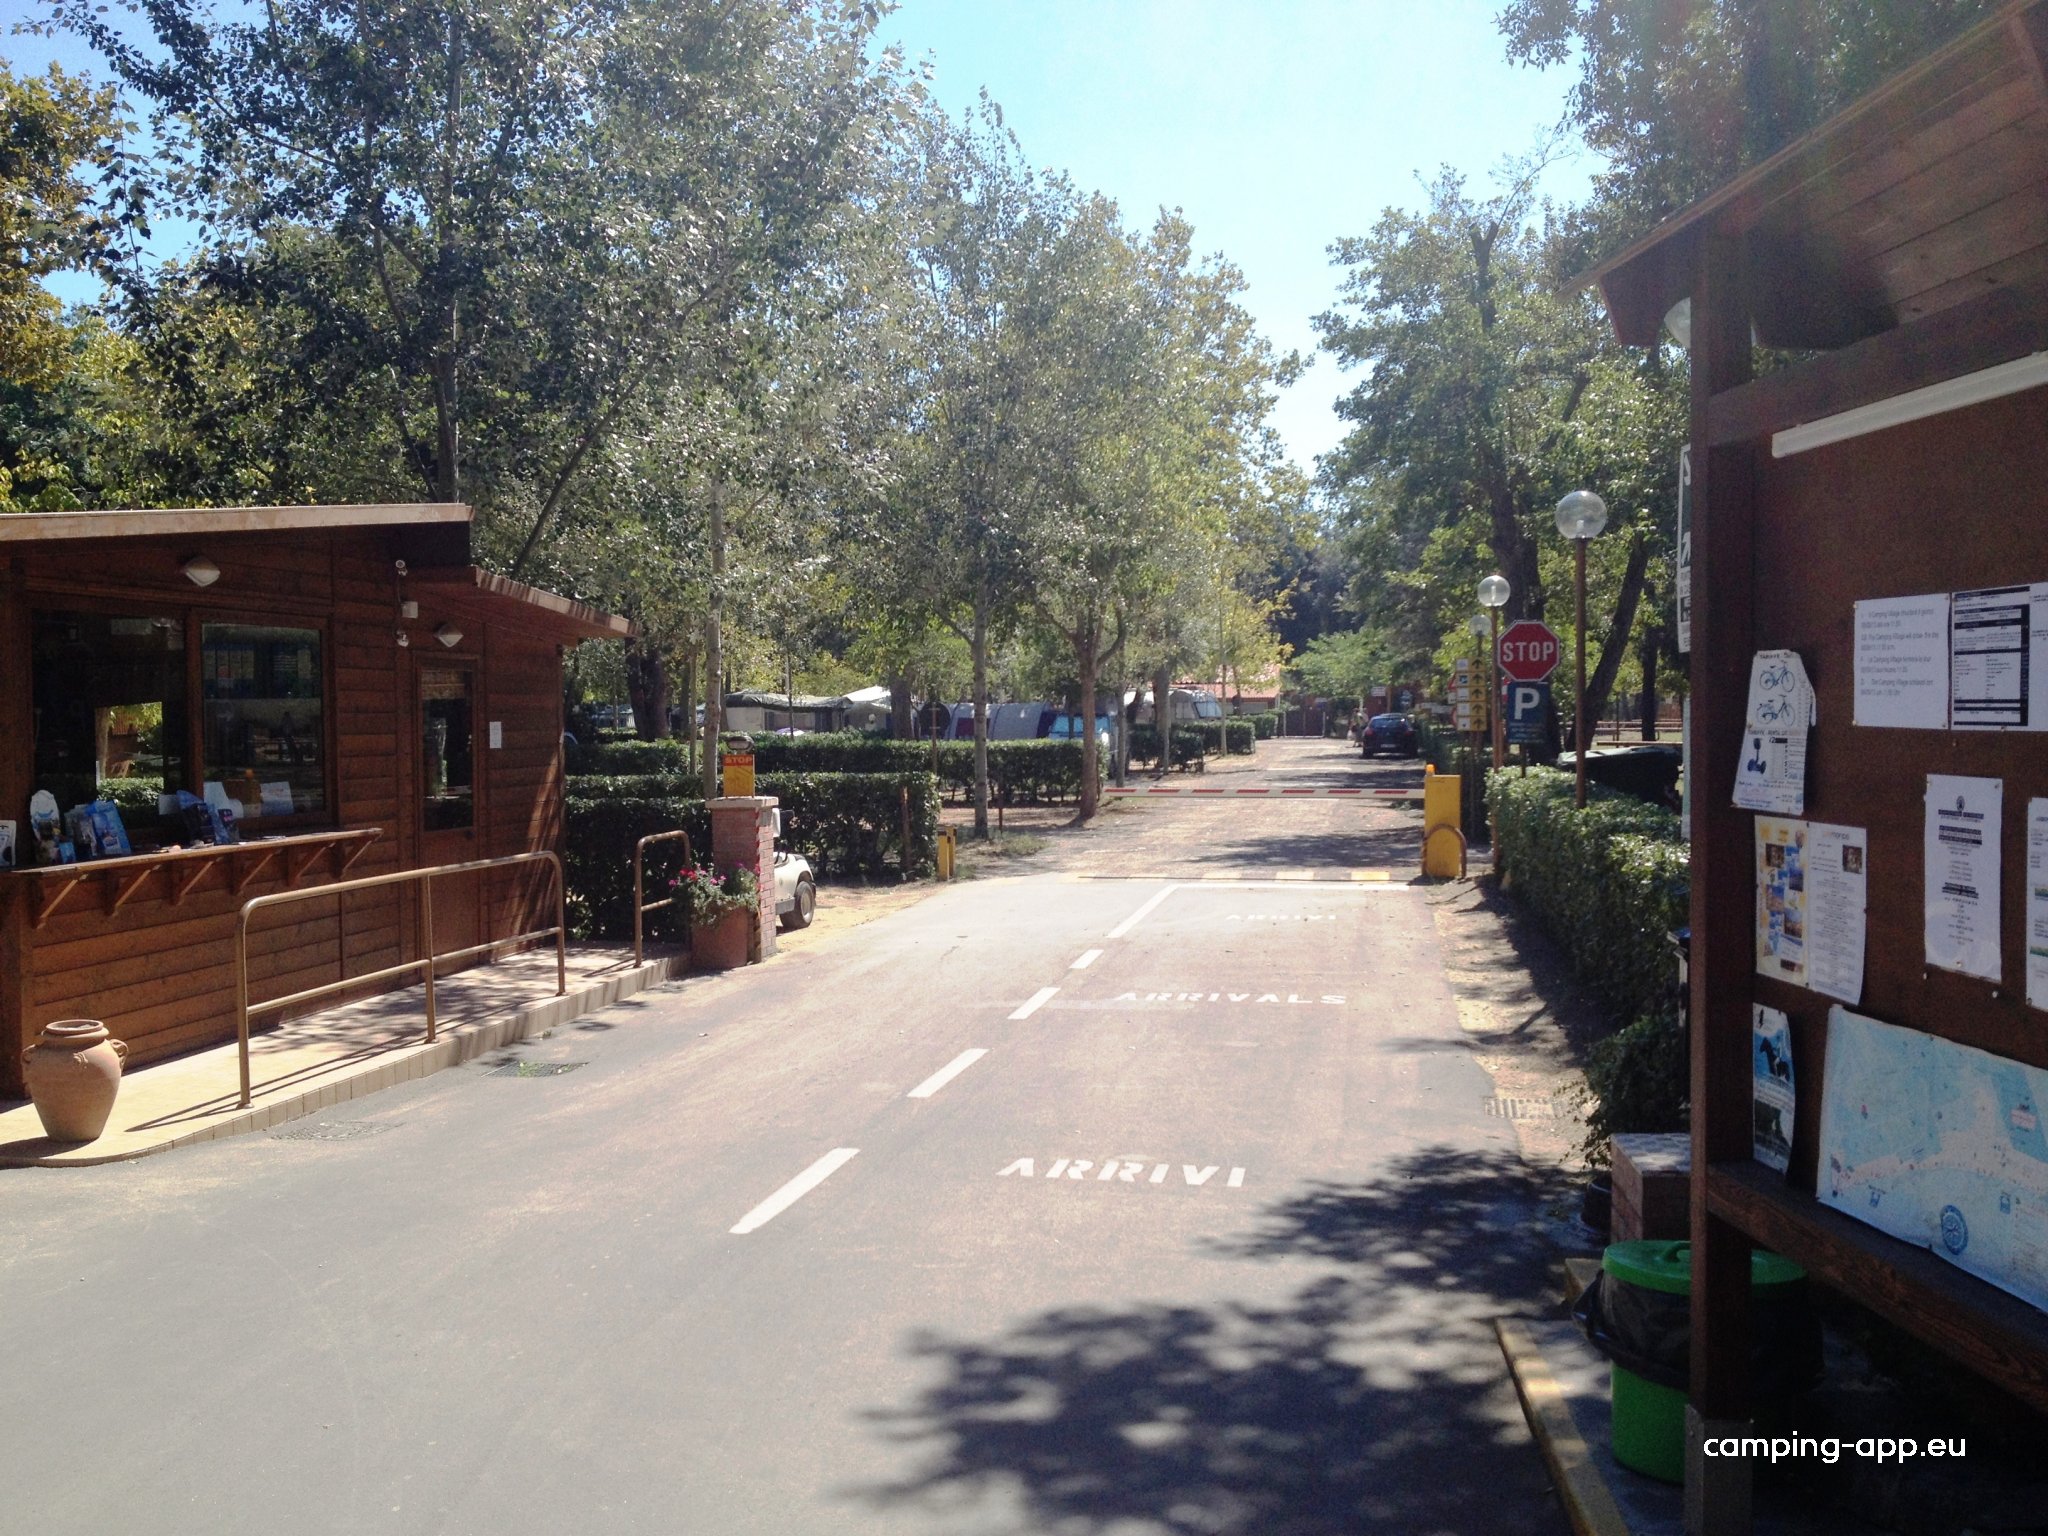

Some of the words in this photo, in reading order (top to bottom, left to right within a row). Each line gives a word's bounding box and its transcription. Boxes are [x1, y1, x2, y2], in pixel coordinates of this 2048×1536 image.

[1503, 642, 1554, 662] STOP
[1514, 687, 1540, 720] P
[724, 756, 753, 764] STOP
[1115, 992, 1346, 1005] ARRIVALS
[996, 1158, 1247, 1187] ARRIVI
